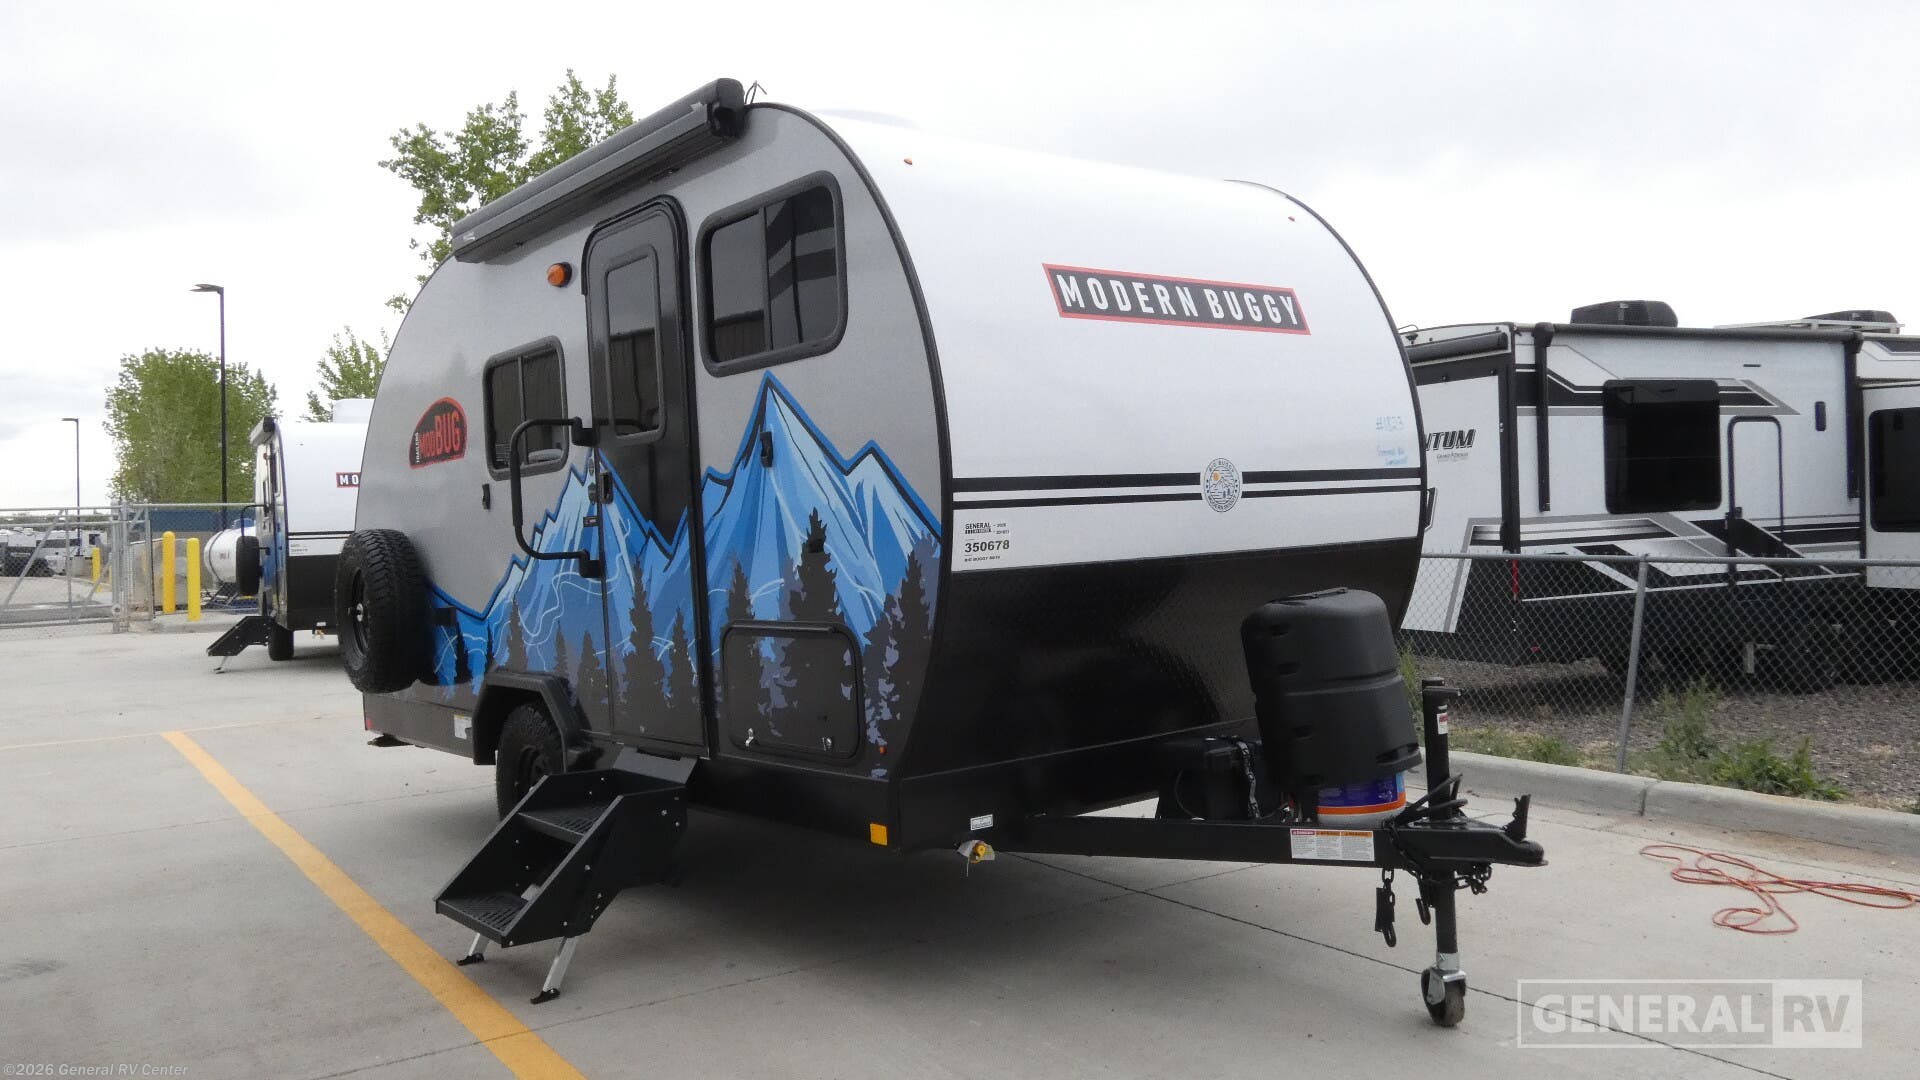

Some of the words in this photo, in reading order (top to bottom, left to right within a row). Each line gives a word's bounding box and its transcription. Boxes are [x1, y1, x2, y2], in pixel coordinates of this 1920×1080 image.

[1056, 274, 1198, 317] MODERN
[1203, 288, 1298, 325] BUGGY
[964, 540, 1010, 553] 350678
